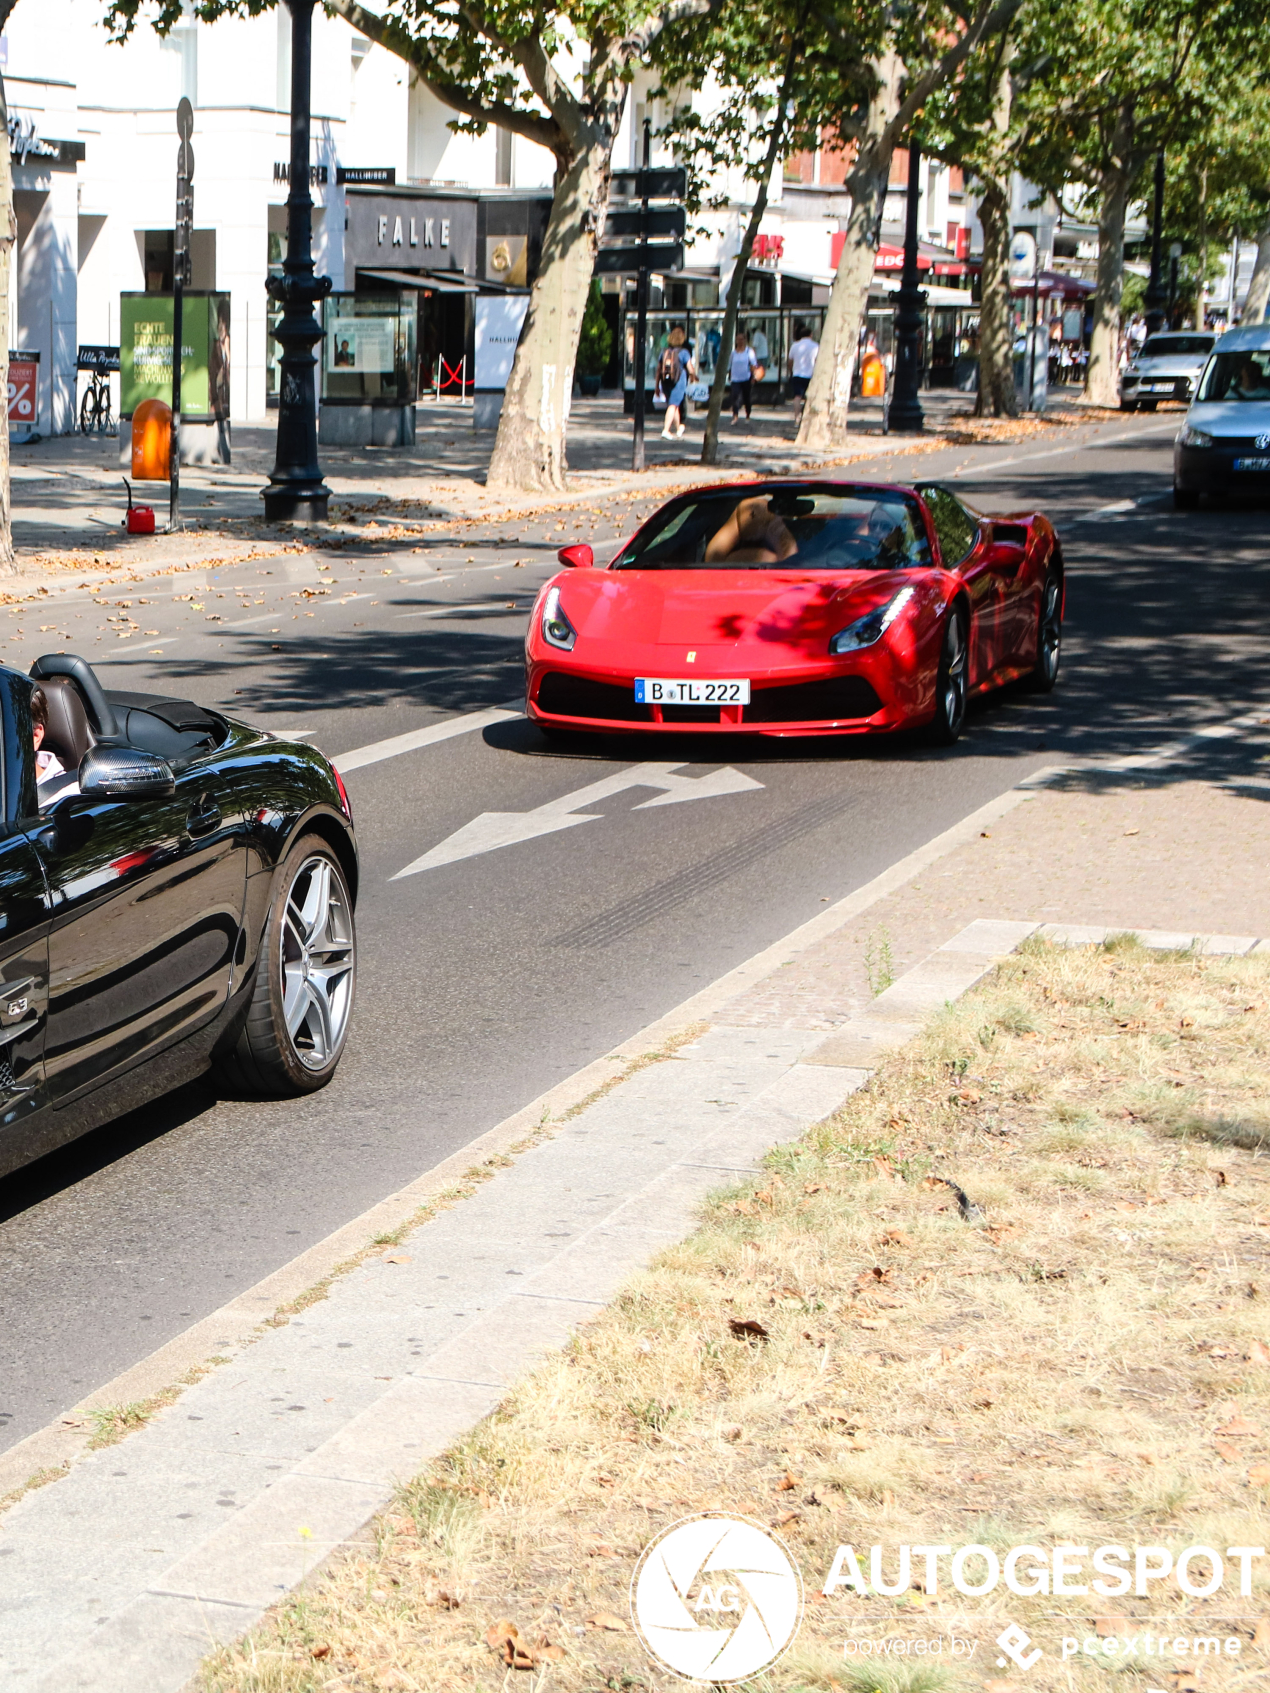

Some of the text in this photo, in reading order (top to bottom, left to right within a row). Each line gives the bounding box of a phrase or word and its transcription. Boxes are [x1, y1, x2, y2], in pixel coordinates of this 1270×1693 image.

[345, 171, 388, 181] HALLHUBER
[378, 214, 450, 248] FALKE
[134, 322, 166, 334] ECHTE
[134, 334, 173, 346] FRAUEN
[79, 350, 97, 363] Ulla
[652, 683, 741, 702] B TL 222
